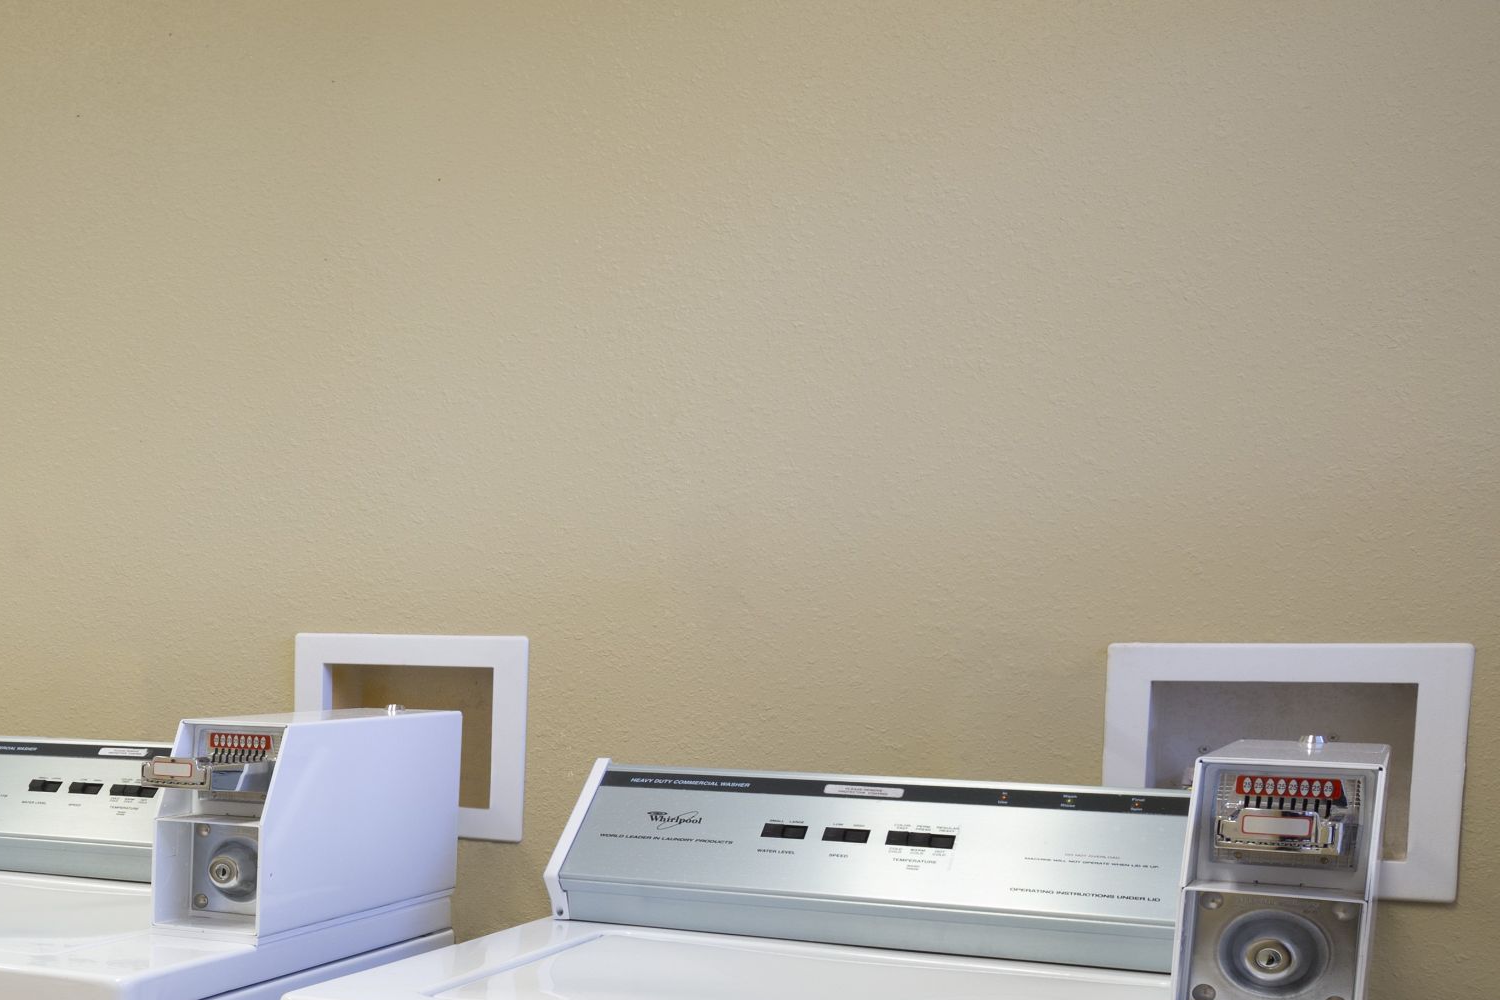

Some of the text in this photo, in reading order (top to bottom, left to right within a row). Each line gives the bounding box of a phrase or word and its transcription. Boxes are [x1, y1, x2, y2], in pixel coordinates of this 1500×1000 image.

[673, 779, 719, 787] COMMERCIAL
[649, 813, 703, 826] Whirlpool
[892, 857, 937, 865] TEMPERATURE
[1009, 887, 1055, 896] OPERATING
[1056, 888, 1115, 899] INSTRUCTIONS
